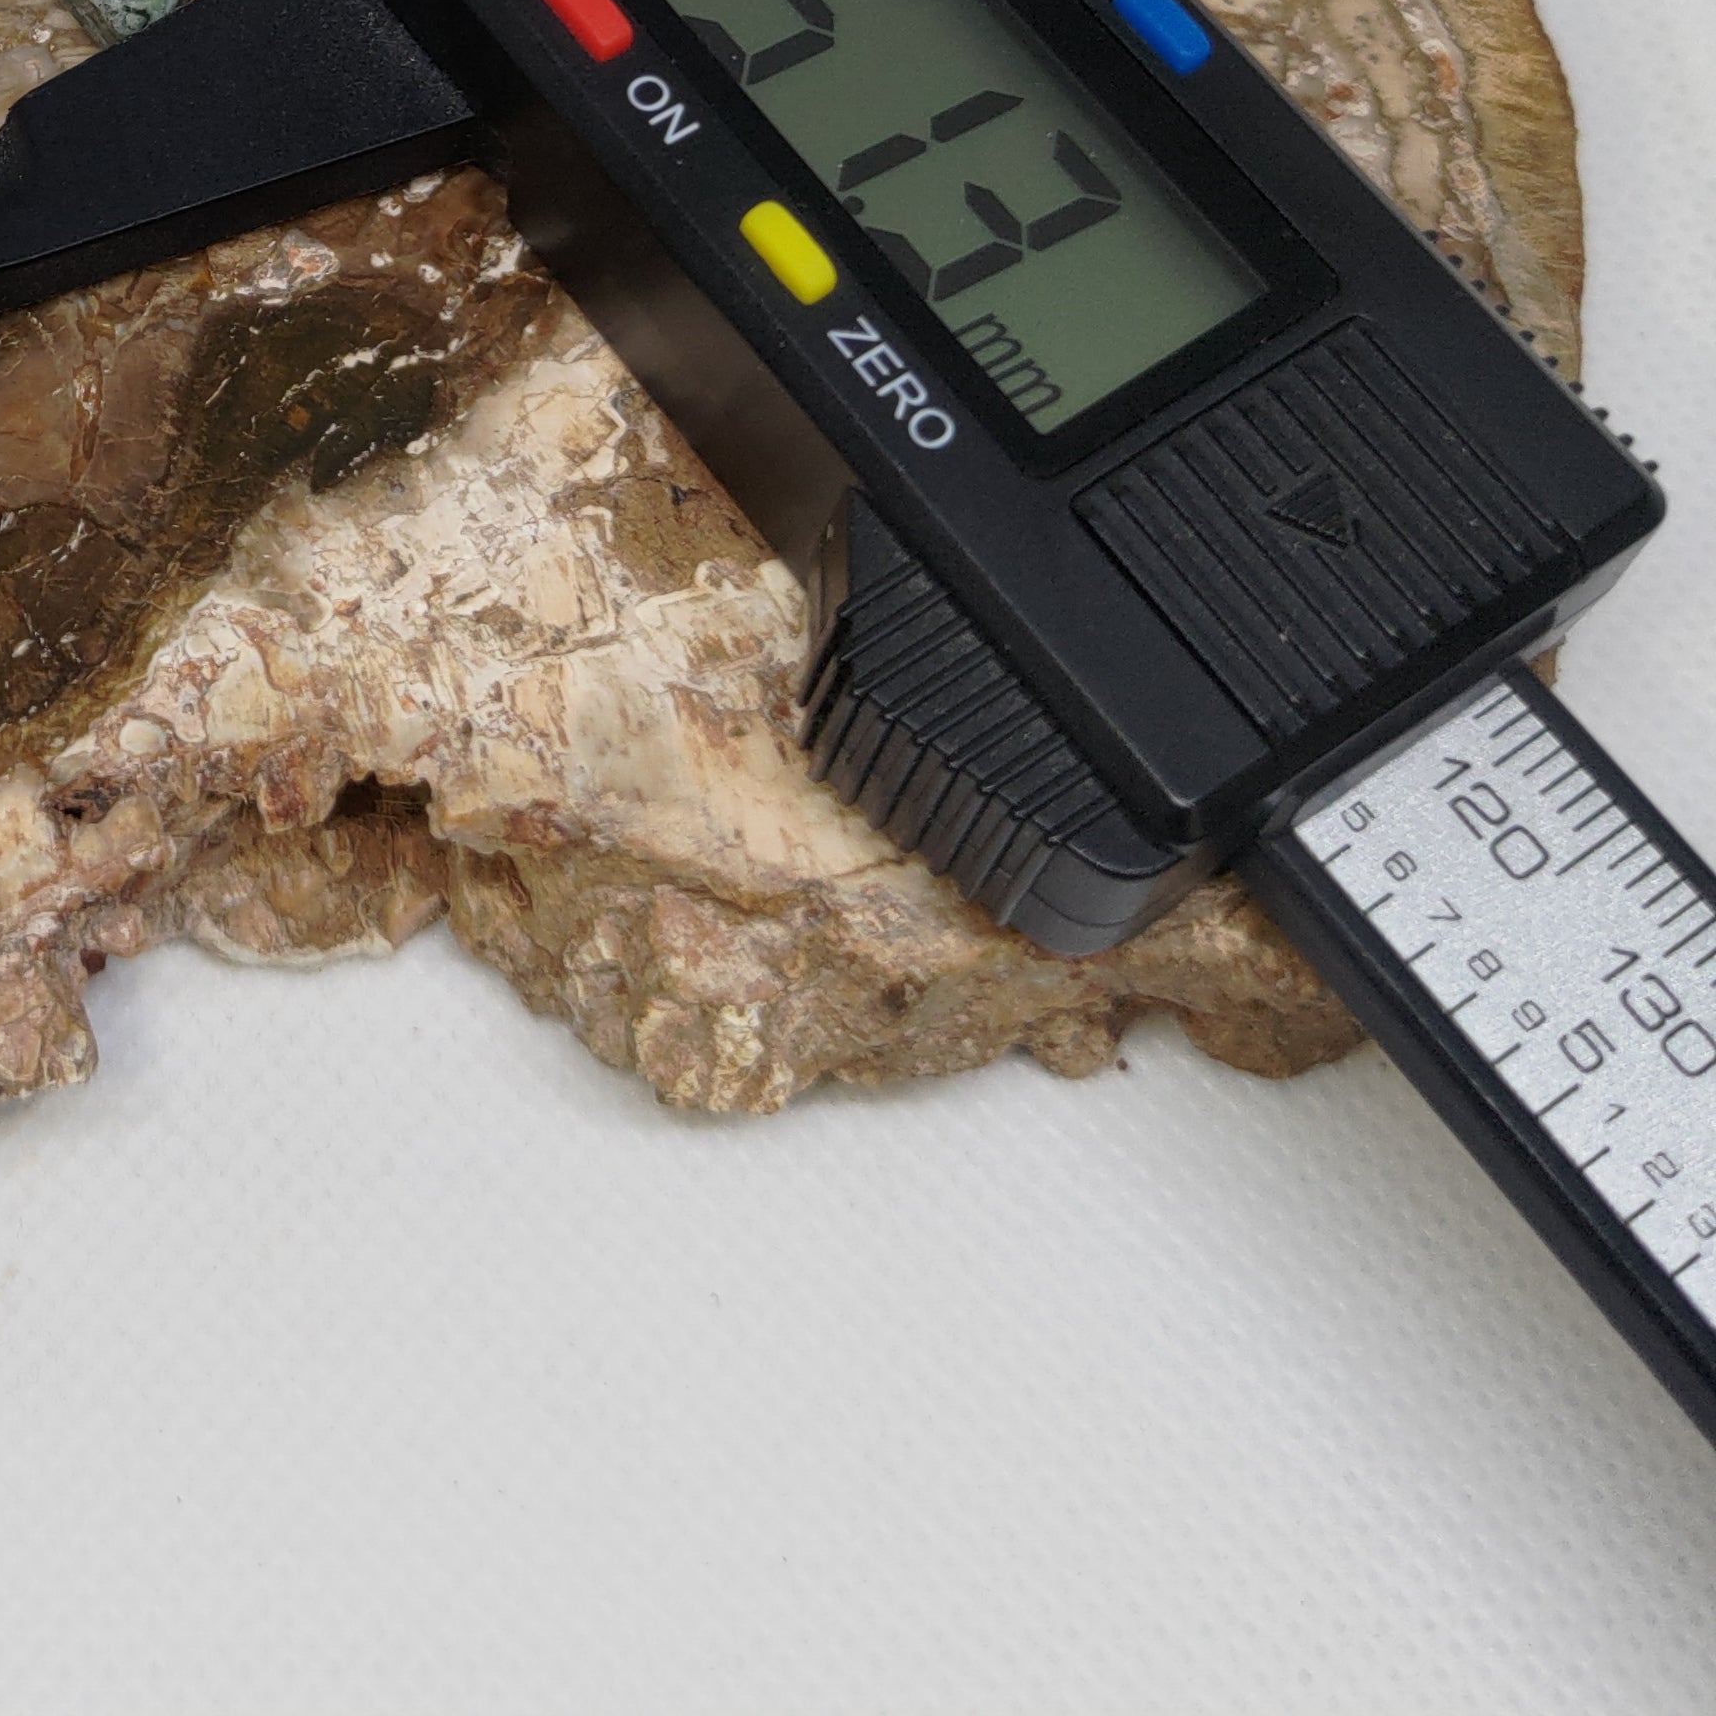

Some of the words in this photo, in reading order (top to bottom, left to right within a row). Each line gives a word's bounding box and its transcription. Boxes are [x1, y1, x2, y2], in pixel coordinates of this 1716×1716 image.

[626, 74, 701, 146] ON
[826, 315, 957, 450] ZERO
[954, 312, 1063, 416] mm
[1431, 756, 1553, 883] 120
[1599, 946, 1716, 1080] 130
[1340, 800, 1379, 834] 5
[1382, 849, 1419, 883] 6
[1425, 896, 1464, 926] 7
[1466, 948, 1507, 983] 8
[1510, 998, 1549, 1033] 9
[1556, 1017, 1618, 1076] 5
[1602, 1101, 1630, 1126] 1
[1640, 1150, 1685, 1189] 2
